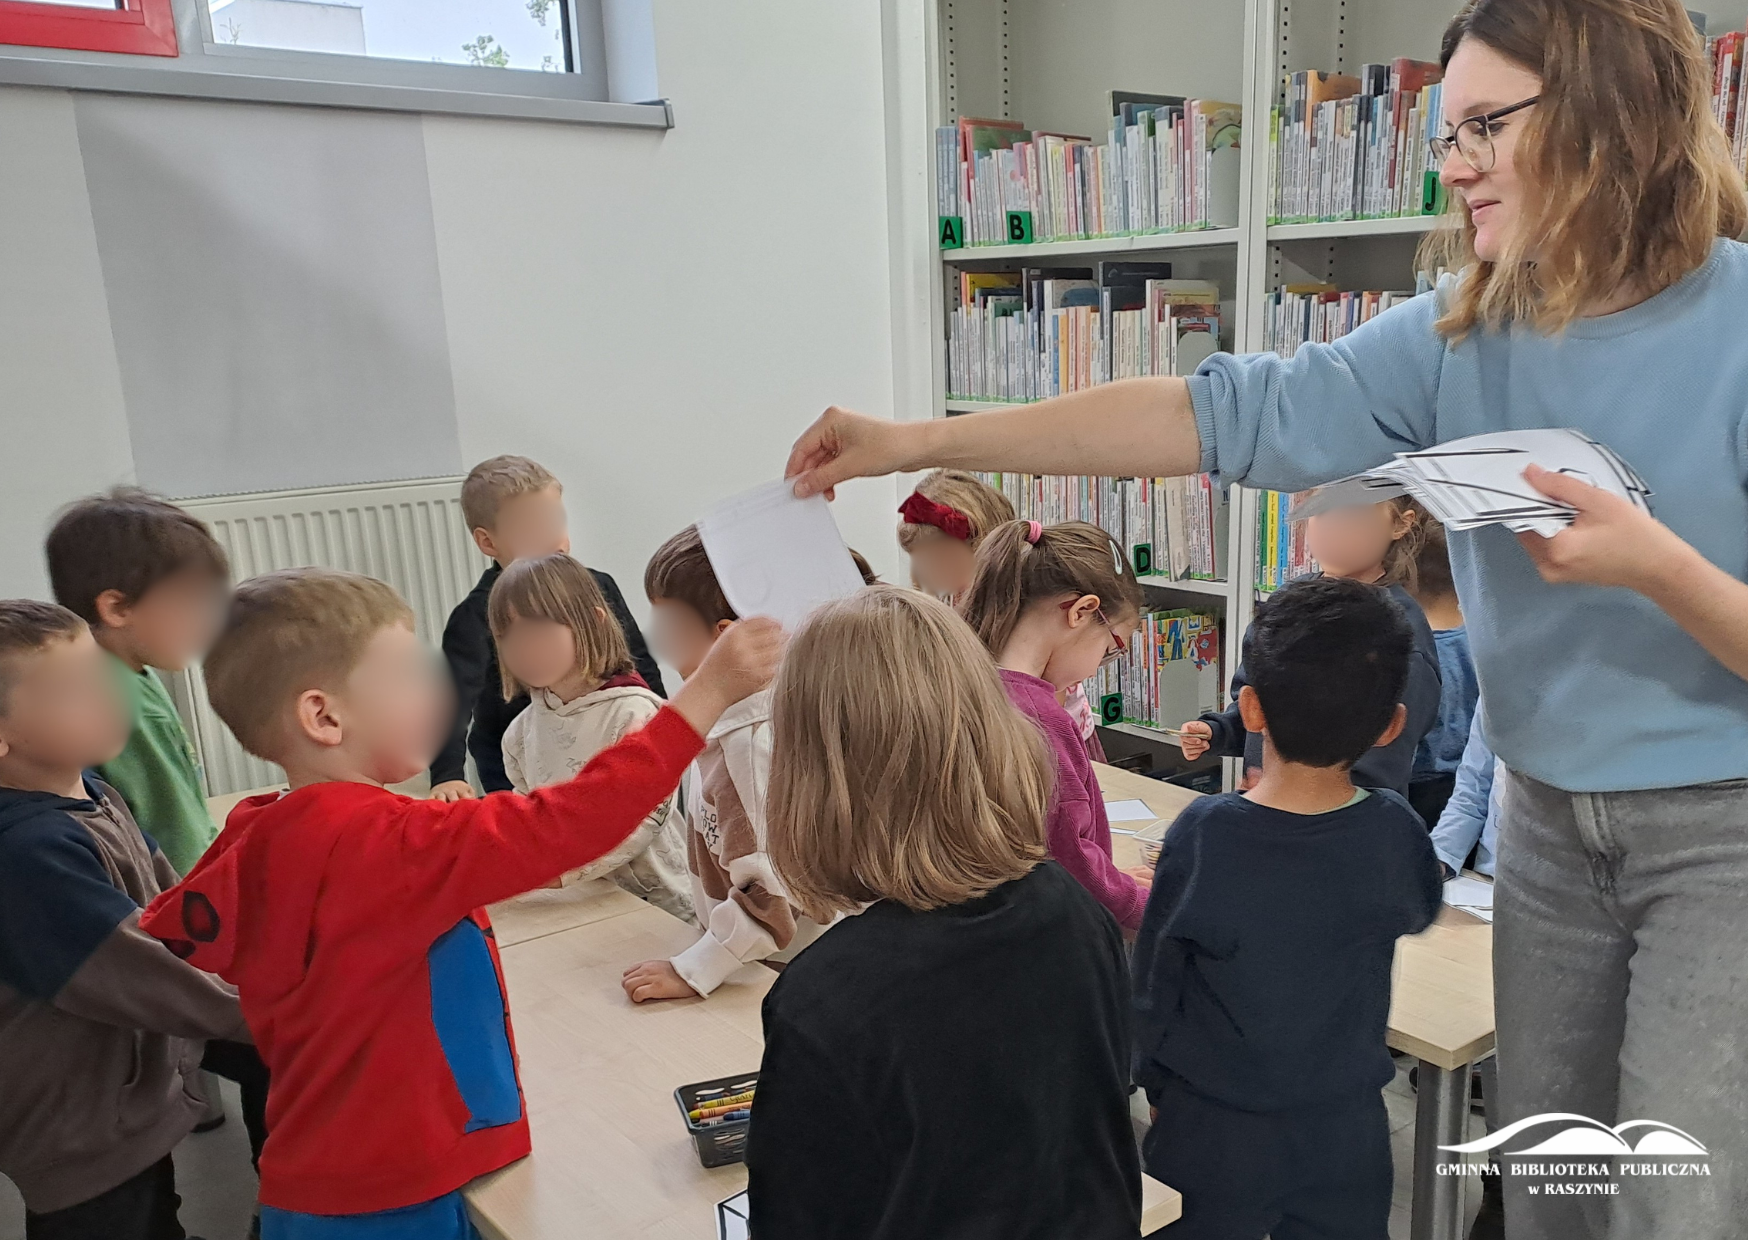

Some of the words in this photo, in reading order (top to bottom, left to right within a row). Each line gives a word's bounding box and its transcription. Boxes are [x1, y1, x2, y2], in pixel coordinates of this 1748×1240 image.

[1425, 177, 1436, 210] J
[941, 219, 957, 245] A
[1010, 214, 1025, 240] B
[1136, 547, 1151, 573] D
[1103, 696, 1120, 721] G
